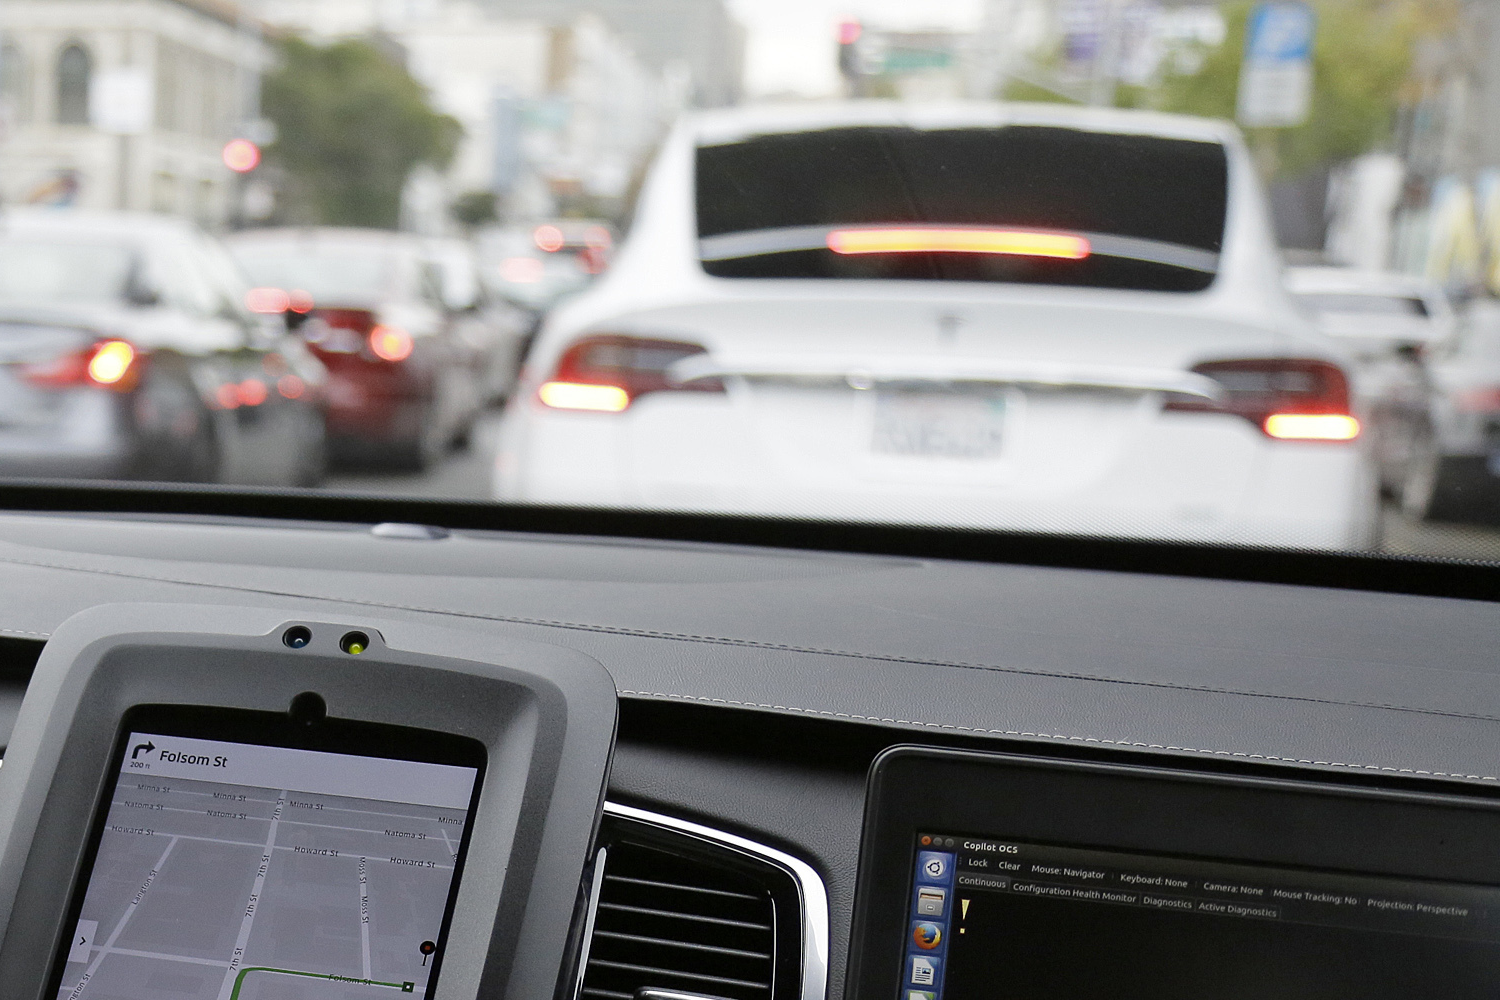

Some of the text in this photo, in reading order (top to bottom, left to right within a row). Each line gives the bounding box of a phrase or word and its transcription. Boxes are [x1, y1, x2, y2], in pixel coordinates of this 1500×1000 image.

[130, 761, 144, 769] 200
[159, 750, 228, 768] Folsom St
[137, 783, 161, 792] Minna
[213, 792, 236, 800] Minna
[124, 801, 164, 811] Natoma St
[271, 798, 285, 820] 7th St
[289, 800, 313, 810] Minna
[206, 810, 237, 819] Natoma
[437, 816, 463, 826] Minna
[111, 825, 143, 835] Howard
[384, 829, 427, 840] Natoma St
[294, 846, 339, 857] Howard St
[963, 841, 1018, 854] Copilot OCS
[257, 854, 270, 878] 7th St
[390, 857, 436, 869] Howard St
[968, 858, 1021, 871] Lock Clear
[1031, 864, 1105, 880] Mouse: Navigator
[958, 876, 1006, 889] Continuous
[1120, 873, 1188, 888] Keyboard: None
[131, 869, 158, 906] Langton St
[1013, 883, 1137, 903] Configuration Health Monitor
[1203, 882, 1264, 896] Camera: None
[1143, 896, 1192, 910] Diagnostics
[1273, 889, 1358, 906] Mouse Tracking: No
[245, 894, 258, 918] 7th St
[361, 896, 369, 924] Moss St
[1199, 902, 1277, 918] Active Diagnostics
[1367, 898, 1469, 917] Projection: Perspective
[229, 947, 243, 971] 7th St
[82, 973, 91, 983] St
[328, 974, 372, 986] Folsom St
